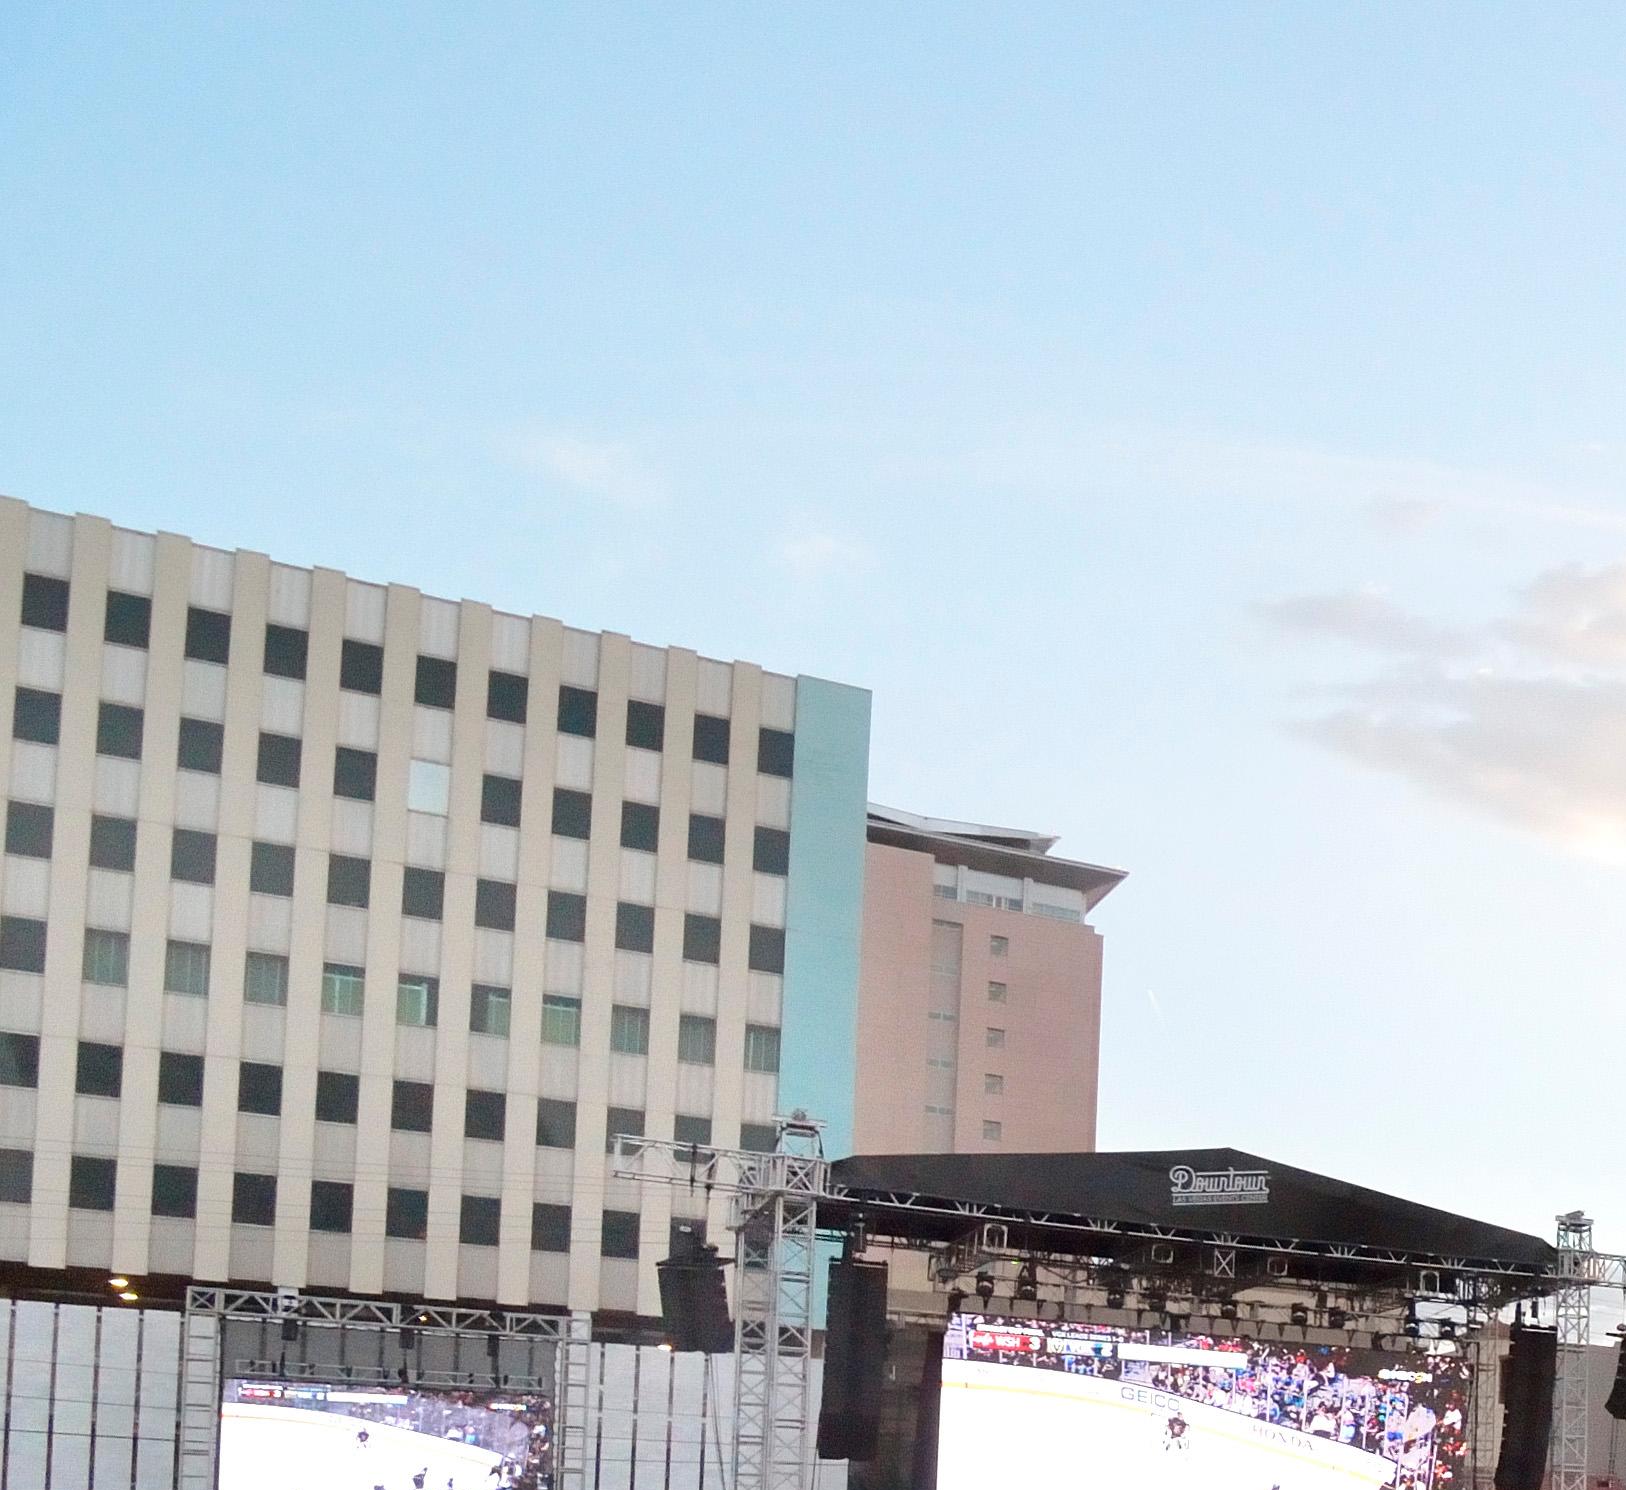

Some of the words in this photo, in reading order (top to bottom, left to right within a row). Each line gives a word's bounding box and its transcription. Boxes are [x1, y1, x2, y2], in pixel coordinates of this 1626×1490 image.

[1169, 1165, 1270, 1193] Downtown
[1120, 1386, 1180, 1411] GEICO
[1252, 1424, 1313, 1451] HONDA
